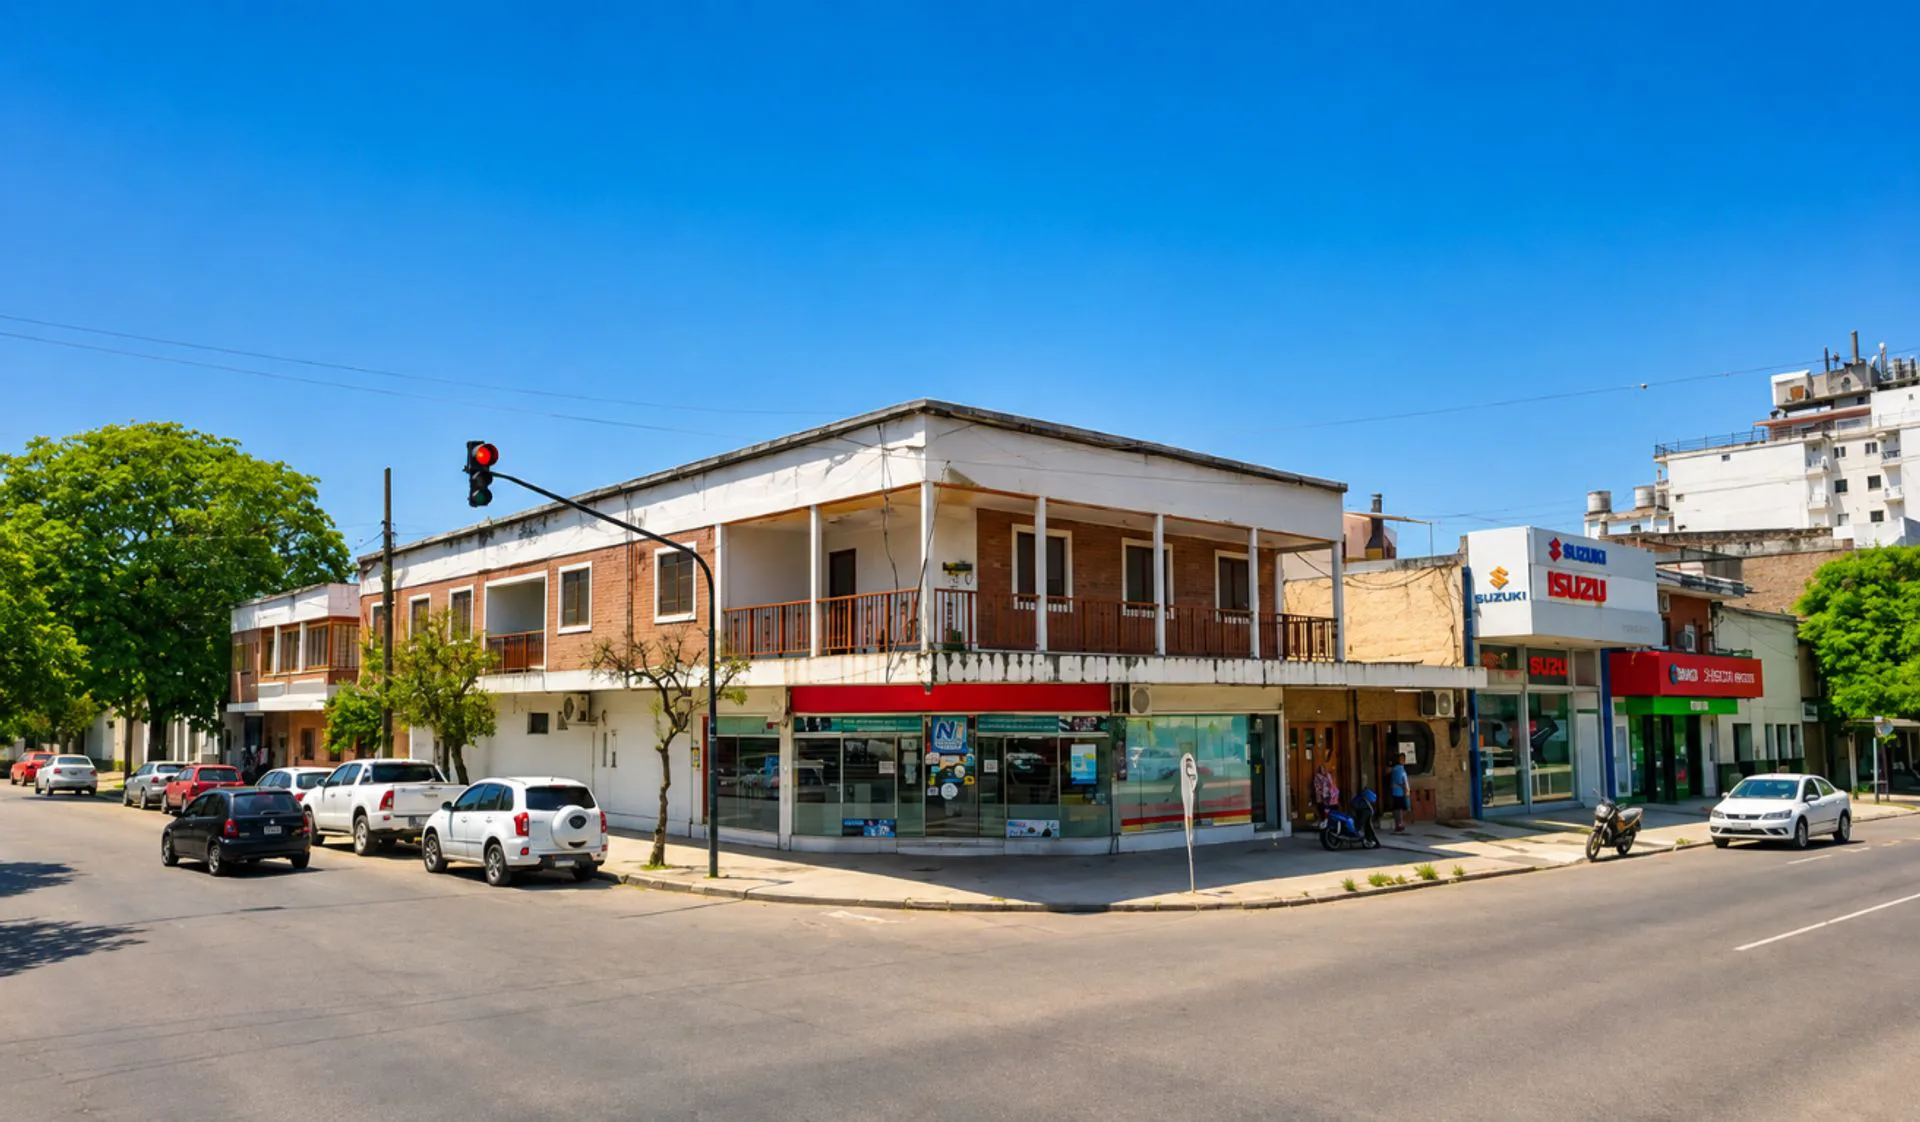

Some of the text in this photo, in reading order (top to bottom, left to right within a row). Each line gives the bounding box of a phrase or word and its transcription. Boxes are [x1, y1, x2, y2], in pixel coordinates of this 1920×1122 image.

[1563, 543, 1606, 565] SUZUKI
[1475, 591, 1526, 604] SUZUKI
[1548, 571, 1607, 602] ISUZU
